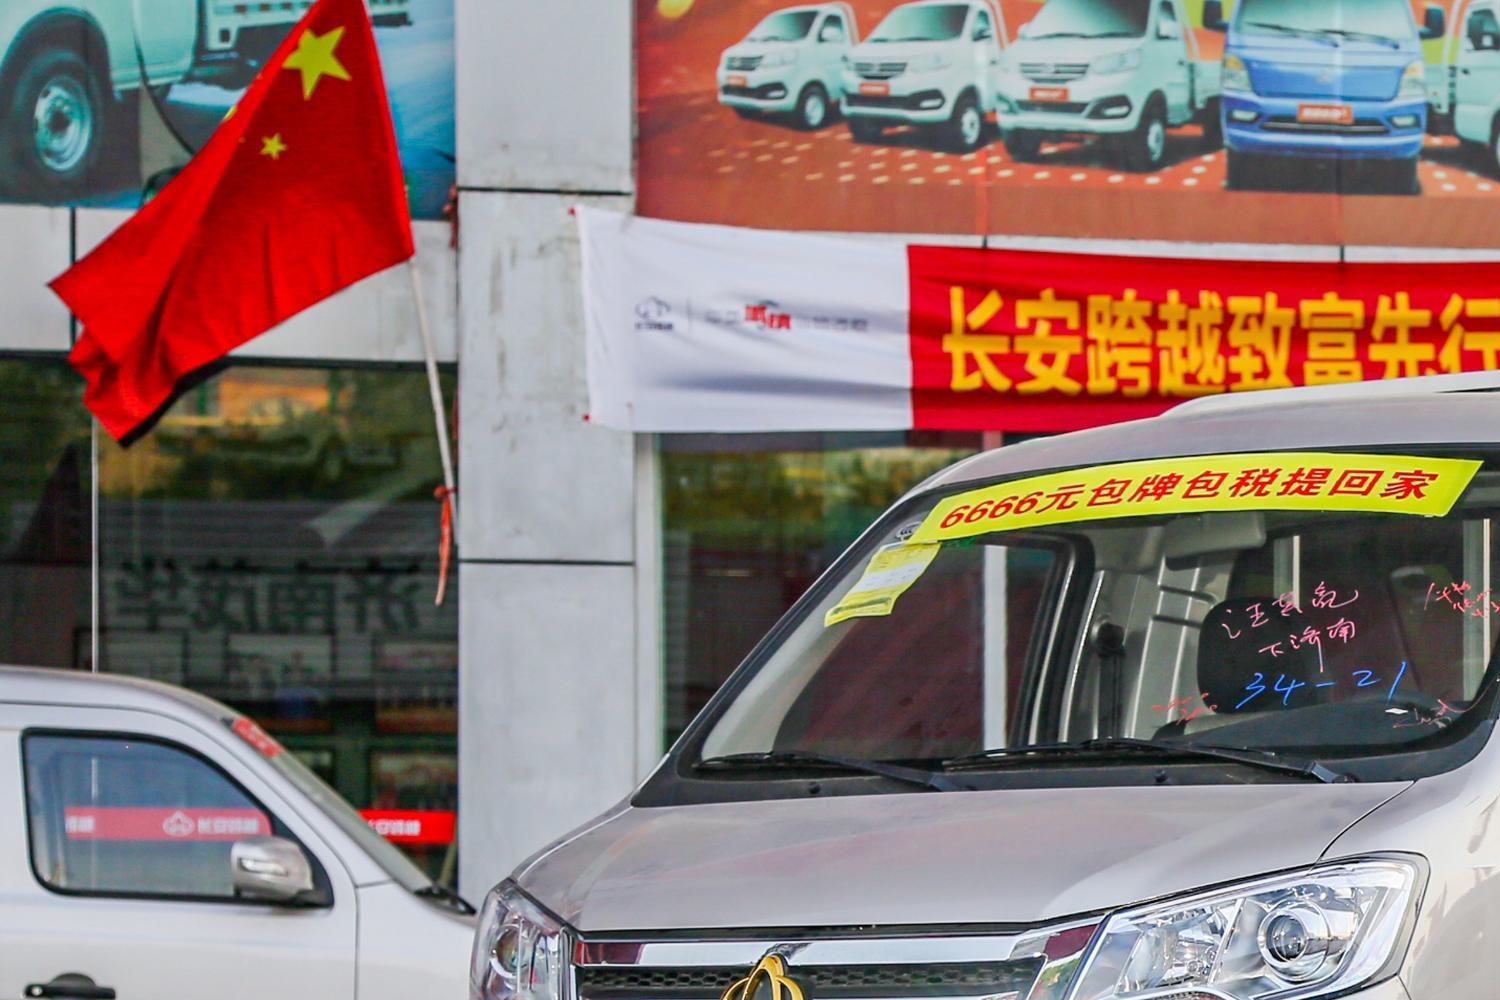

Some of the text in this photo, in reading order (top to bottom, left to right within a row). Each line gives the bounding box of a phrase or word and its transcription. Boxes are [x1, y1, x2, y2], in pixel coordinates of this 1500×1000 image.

[940, 467, 1438, 529] 6666元包牌包税提回家
